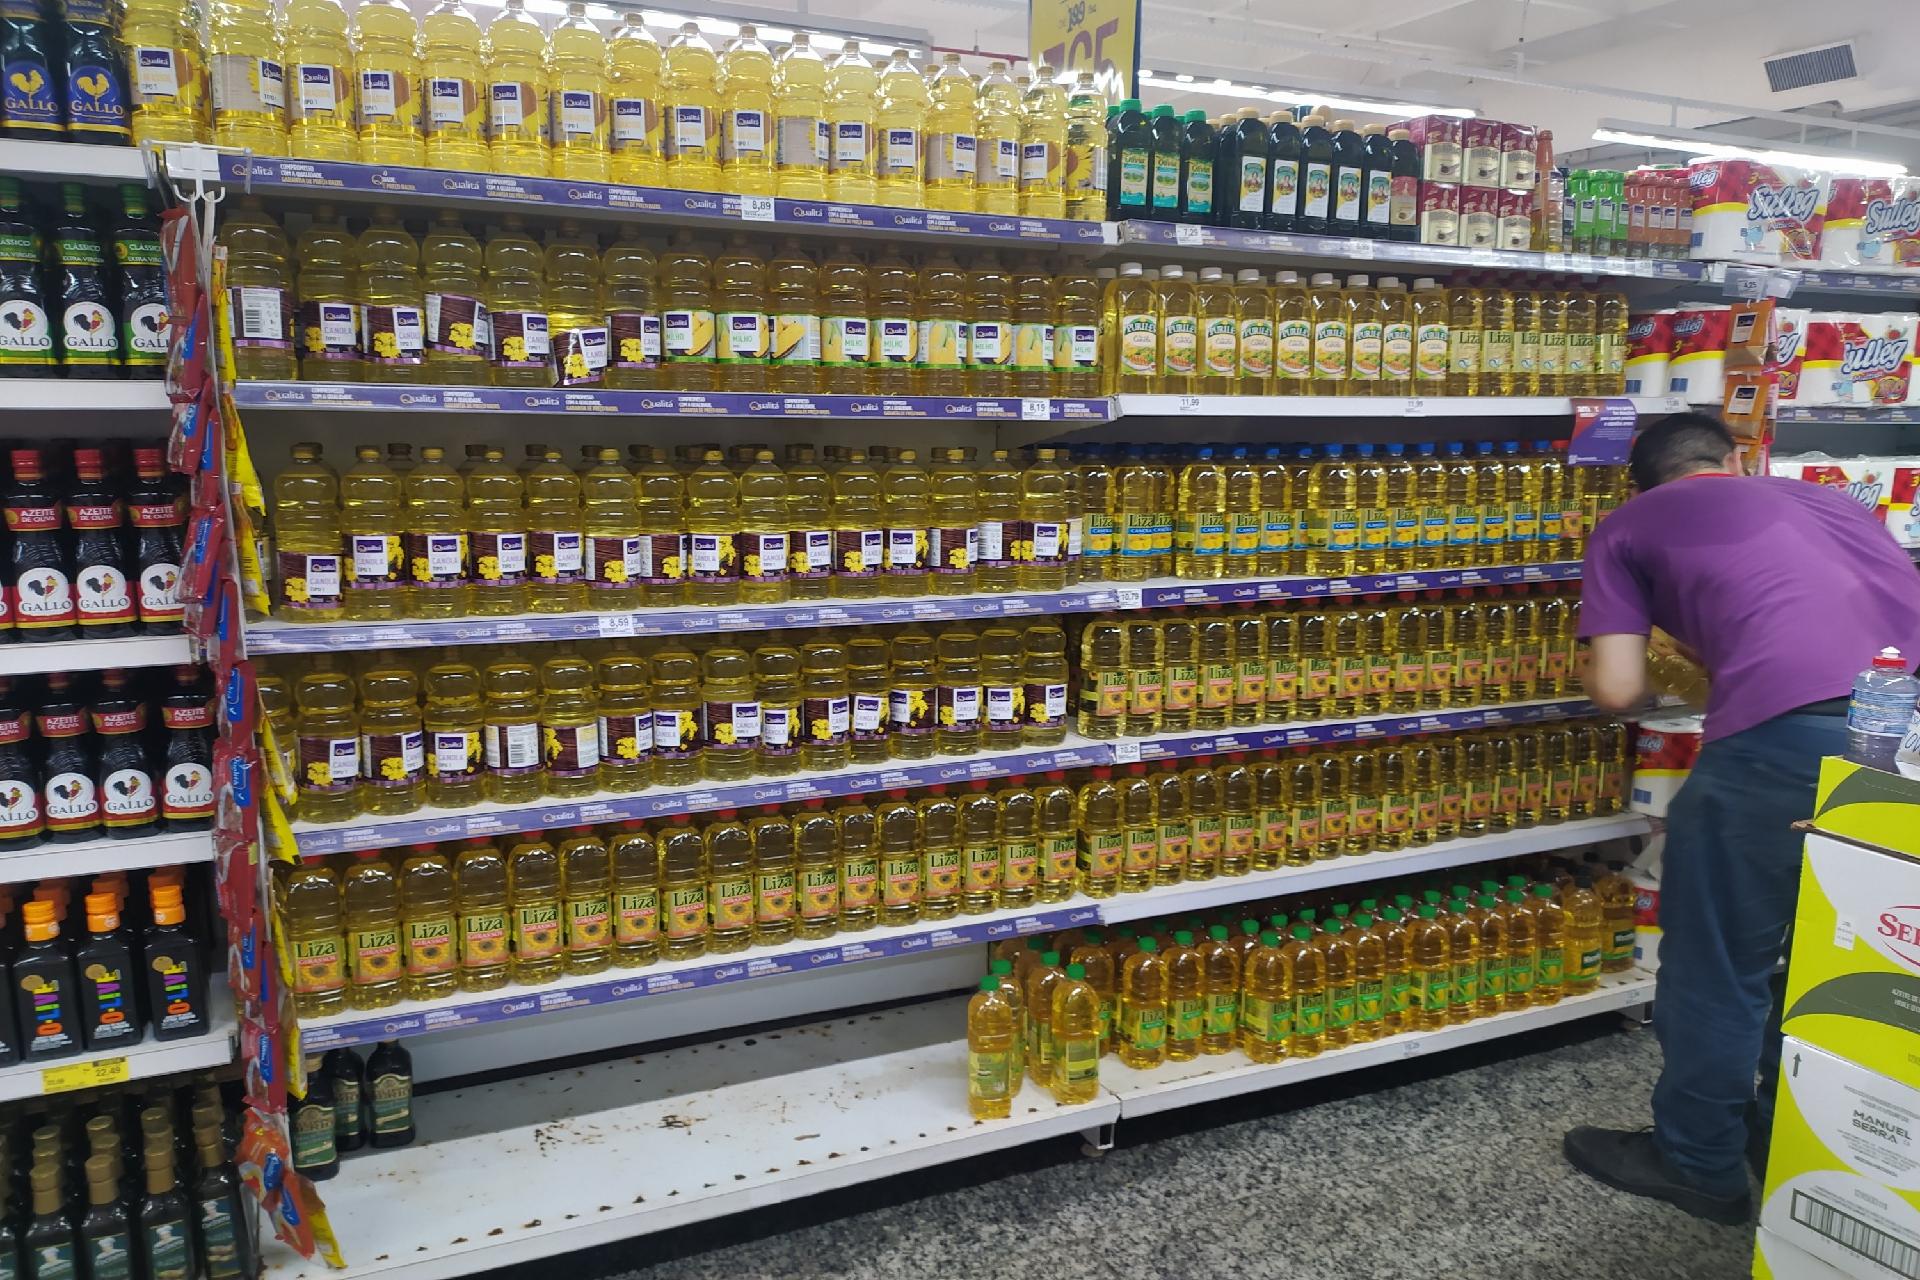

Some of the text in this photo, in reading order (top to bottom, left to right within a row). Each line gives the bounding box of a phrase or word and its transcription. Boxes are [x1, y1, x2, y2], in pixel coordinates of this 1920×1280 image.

[303, 72, 329, 84] Qualitá
[5, 97, 58, 113] GALLO
[71, 99, 124, 116] GALLO
[443, 178, 479, 190] Qualitá
[568, 188, 602, 200] Qualitá
[684, 198, 717, 210] Qualitá
[752, 200, 772, 211] 8,89
[793, 207, 823, 218] Qualitá
[64, 243, 101, 252] CLÁSSICO
[325, 311, 350, 322] Qualitá
[67, 337, 117, 348] GALLO
[134, 337, 170, 348] GALL
[1459, 331, 1480, 344] Liza
[1489, 331, 1511, 344] Liza
[1544, 333, 1566, 346] Liza
[1570, 334, 1594, 347] Liza
[265, 389, 305, 401] Qualitá
[400, 393, 437, 404] Qualitá
[525, 396, 560, 407] Qualitá
[641, 398, 674, 410] Qualitá
[749, 400, 780, 411] Qualitá
[20, 508, 55, 517] AZEITE
[79, 507, 113, 516] AZEITE
[142, 506, 174, 515] AZEITE
[33, 514, 56, 522] OLIVA
[91, 513, 114, 521] OLIVA
[21, 600, 72, 612] GALLO
[80, 597, 129, 610] GALLO
[104, 713, 136, 723] AZEITE
[174, 708, 205, 717] AZEITE
[47, 716, 78, 726] AZEITE
[108, 797, 155, 811] GALLO
[168, 794, 213, 804] GALLO
[49, 802, 97, 815] GALLO
[0, 809, 37, 824] ALLO
[543, 811, 575, 823] Qualitá
[426, 825, 461, 837] Qualitá
[931, 852, 959, 868] Liza
[972, 848, 999, 864] Liza
[847, 862, 877, 877] Liza
[890, 859, 918, 876] Liza
[763, 874, 793, 891] Liza
[807, 871, 837, 888] Liza
[721, 881, 753, 898] Liza
[622, 893, 657, 911] Liza
[673, 889, 705, 907] Liza
[574, 901, 608, 917] Liza
[523, 907, 558, 925] Liza
[467, 915, 504, 933] Liza
[411, 922, 449, 940] Liza
[358, 931, 397, 949] Liza
[296, 942, 336, 958] Liza
[1853, 1109, 1912, 1140] MANUEL
[1852, 1118, 1898, 1144] SERRA
